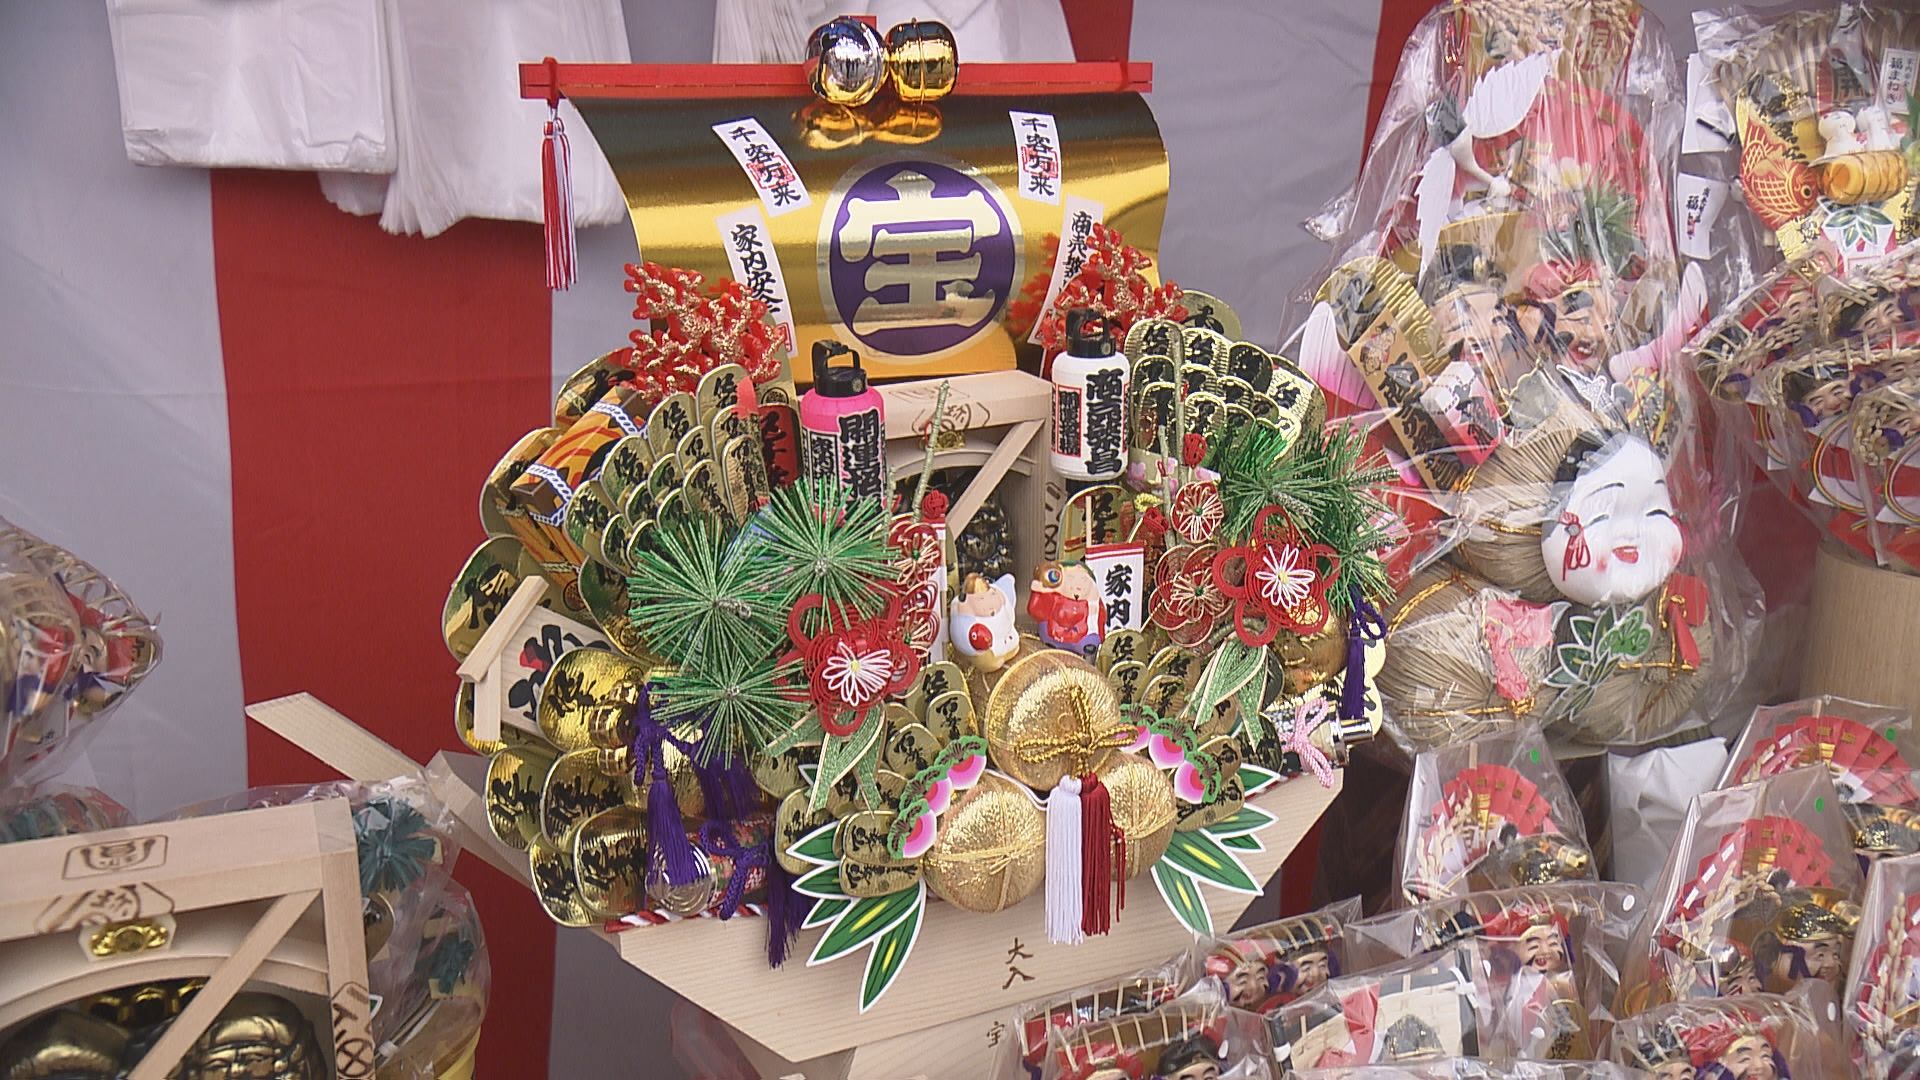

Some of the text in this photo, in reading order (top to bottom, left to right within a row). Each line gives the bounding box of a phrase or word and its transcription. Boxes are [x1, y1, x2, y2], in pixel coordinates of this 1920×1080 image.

[728, 126, 801, 207] 千客万来
[1021, 117, 1054, 196] 千客万来
[838, 408, 882, 514] 開運招
[1105, 564, 1133, 630] 家内
[1002, 937, 1035, 990] 大入
